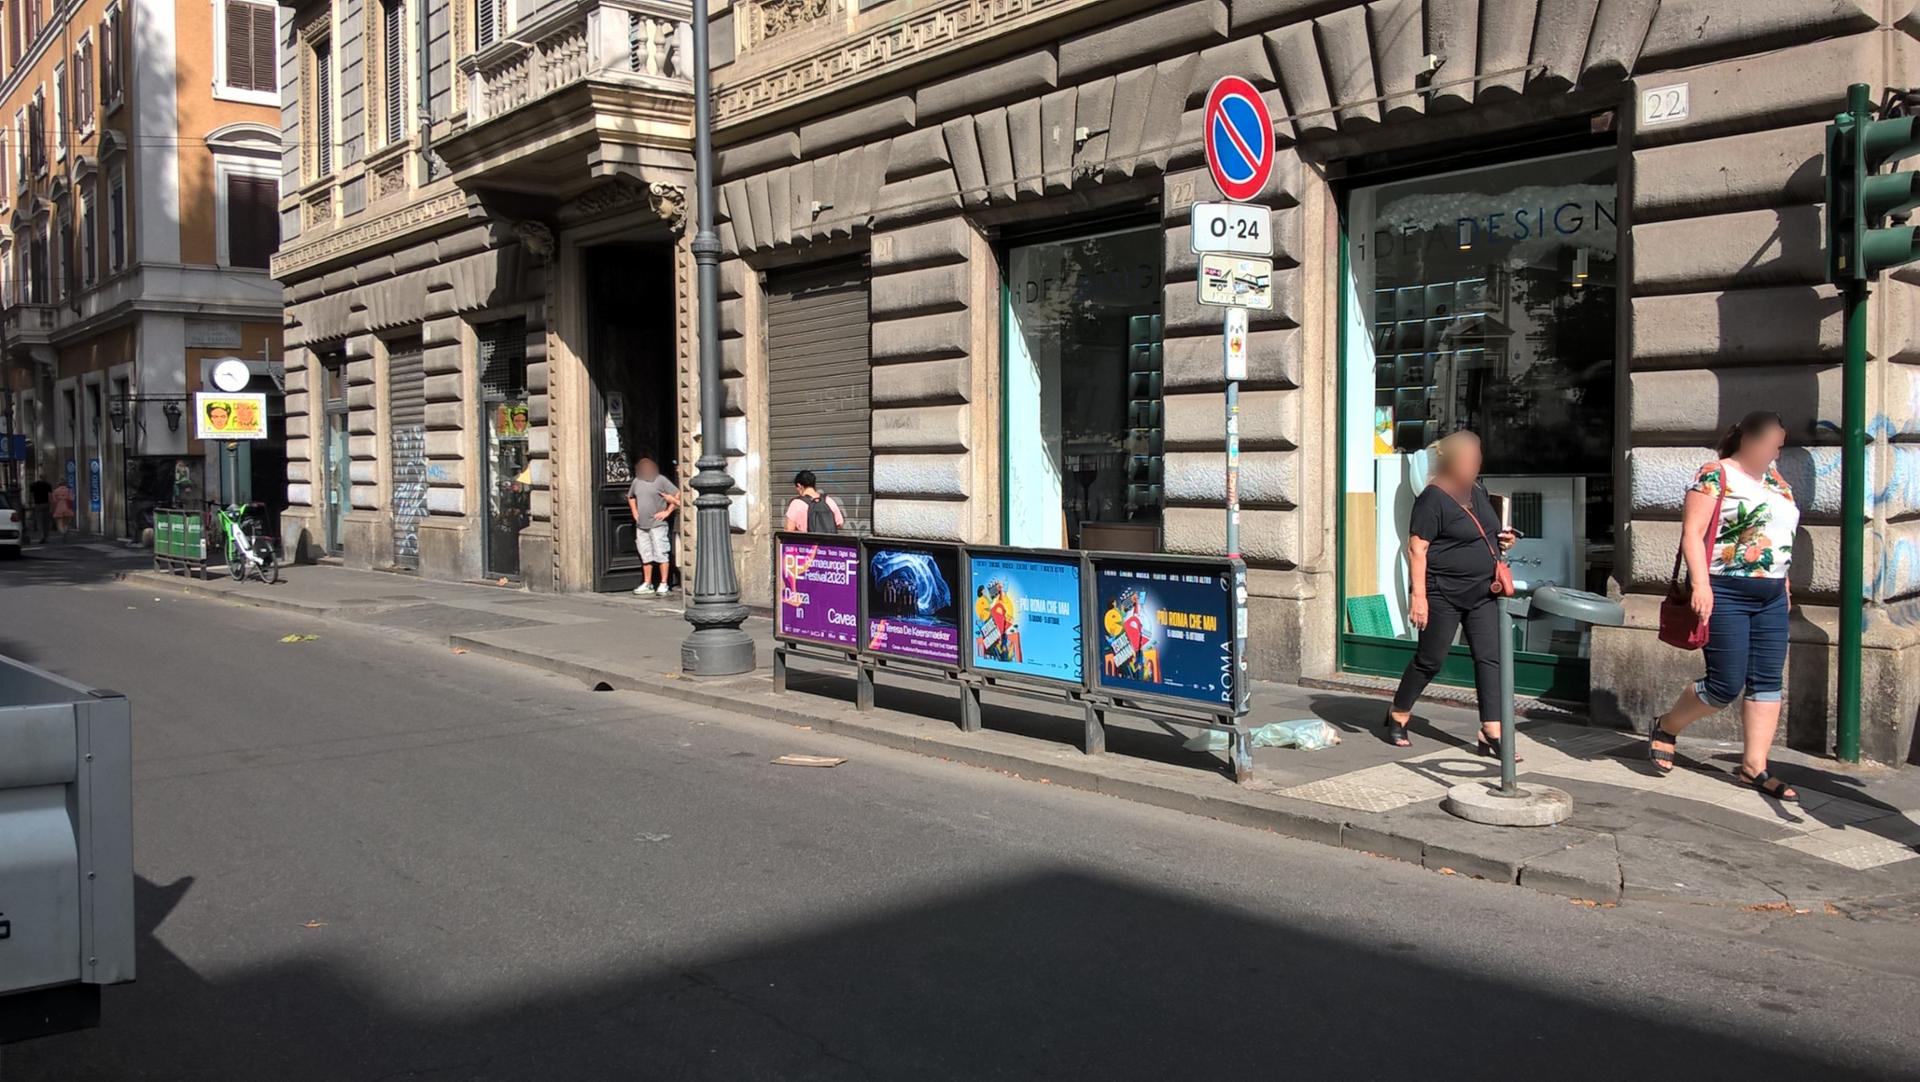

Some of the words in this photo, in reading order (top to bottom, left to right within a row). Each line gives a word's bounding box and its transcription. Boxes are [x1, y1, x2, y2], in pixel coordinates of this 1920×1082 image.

[1173, 183, 1192, 204] 22
[805, 555, 846, 573] Romaeuropa
[785, 587, 810, 605] Danza
[796, 607, 804, 619] in
[1030, 598, 1046, 613] ROMA
[1047, 600, 1058, 614] CHE
[1058, 601, 1070, 616] MAI
[827, 608, 857, 627] Cavea
[1168, 612, 1188, 629] ROMA
[1189, 613, 1202, 630] CHE
[1203, 615, 1217, 632] MAI
[1072, 624, 1084, 679] ROMA
[1220, 641, 1234, 702] ROMA
